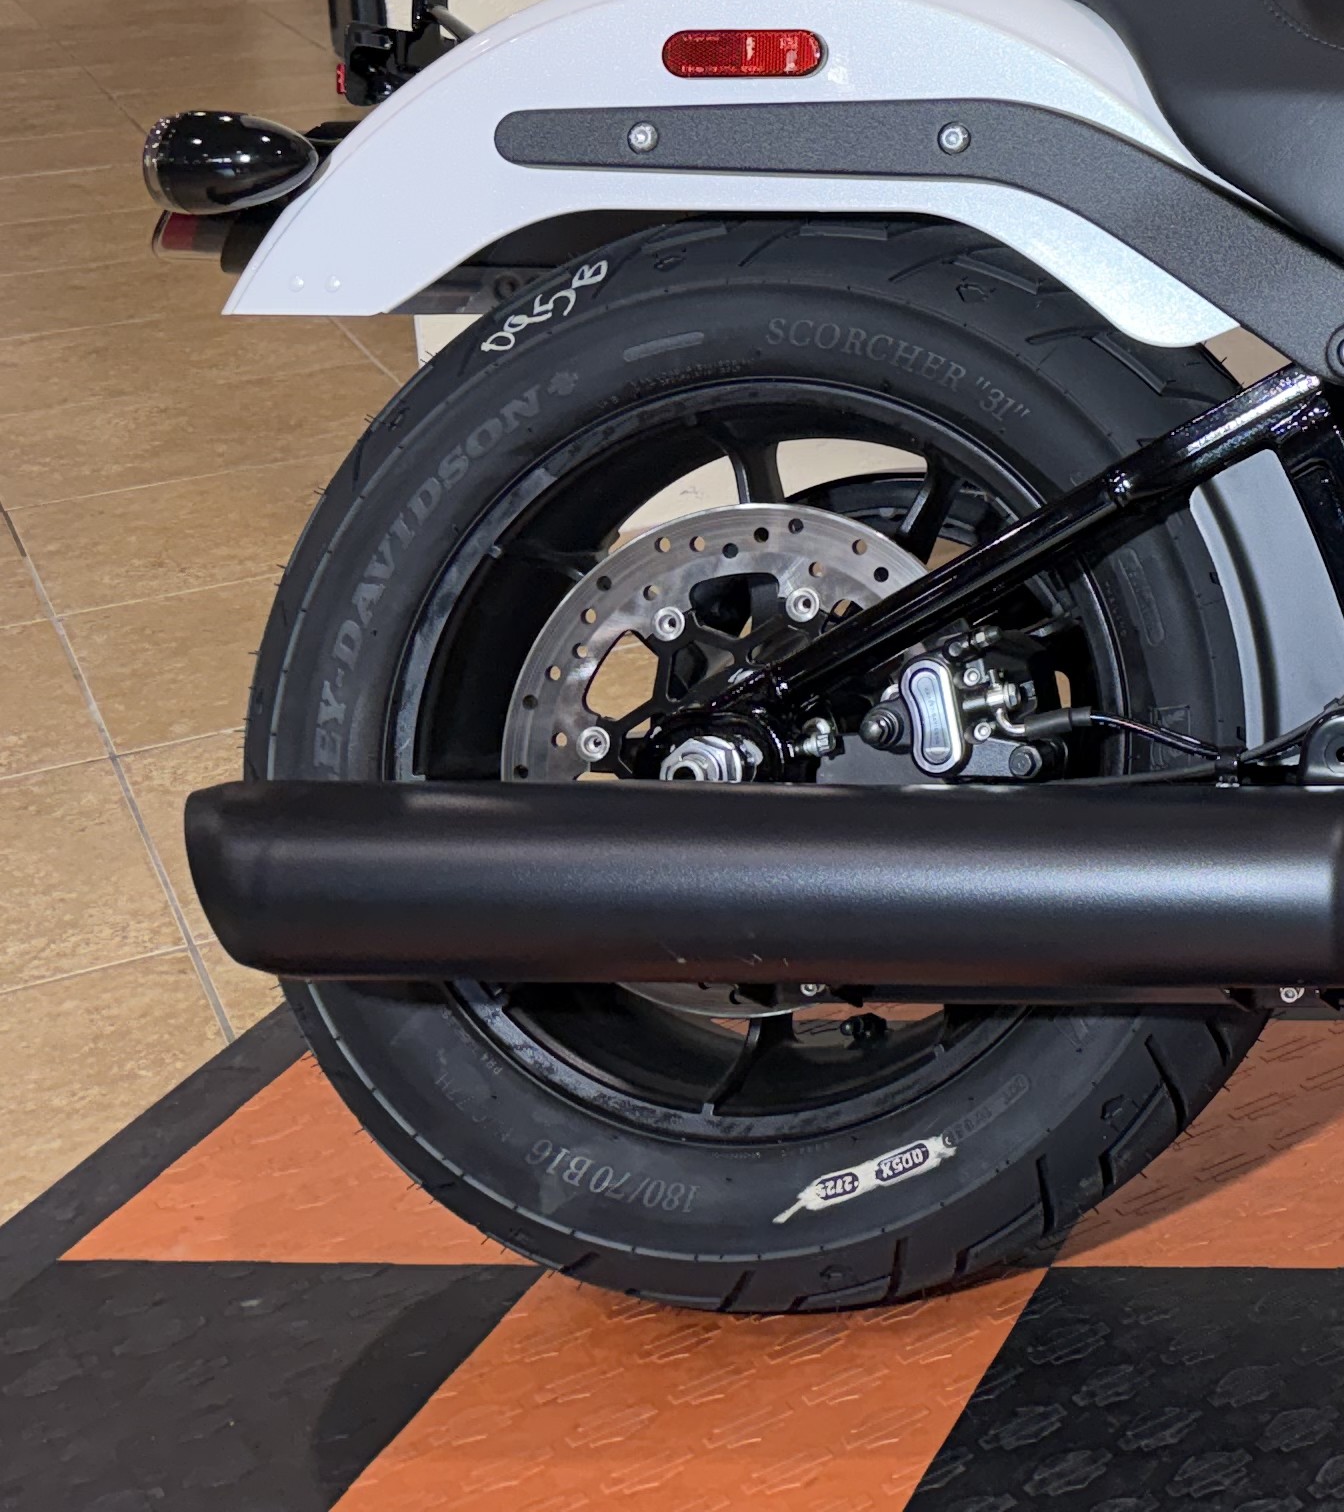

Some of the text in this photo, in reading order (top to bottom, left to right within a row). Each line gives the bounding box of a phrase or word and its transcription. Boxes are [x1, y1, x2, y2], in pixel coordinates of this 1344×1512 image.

[765, 318, 966, 393] SCORCHER
[314, 384, 543, 781] EY-DAVIDSON
[524, 1138, 701, 1213] 180/70B16
